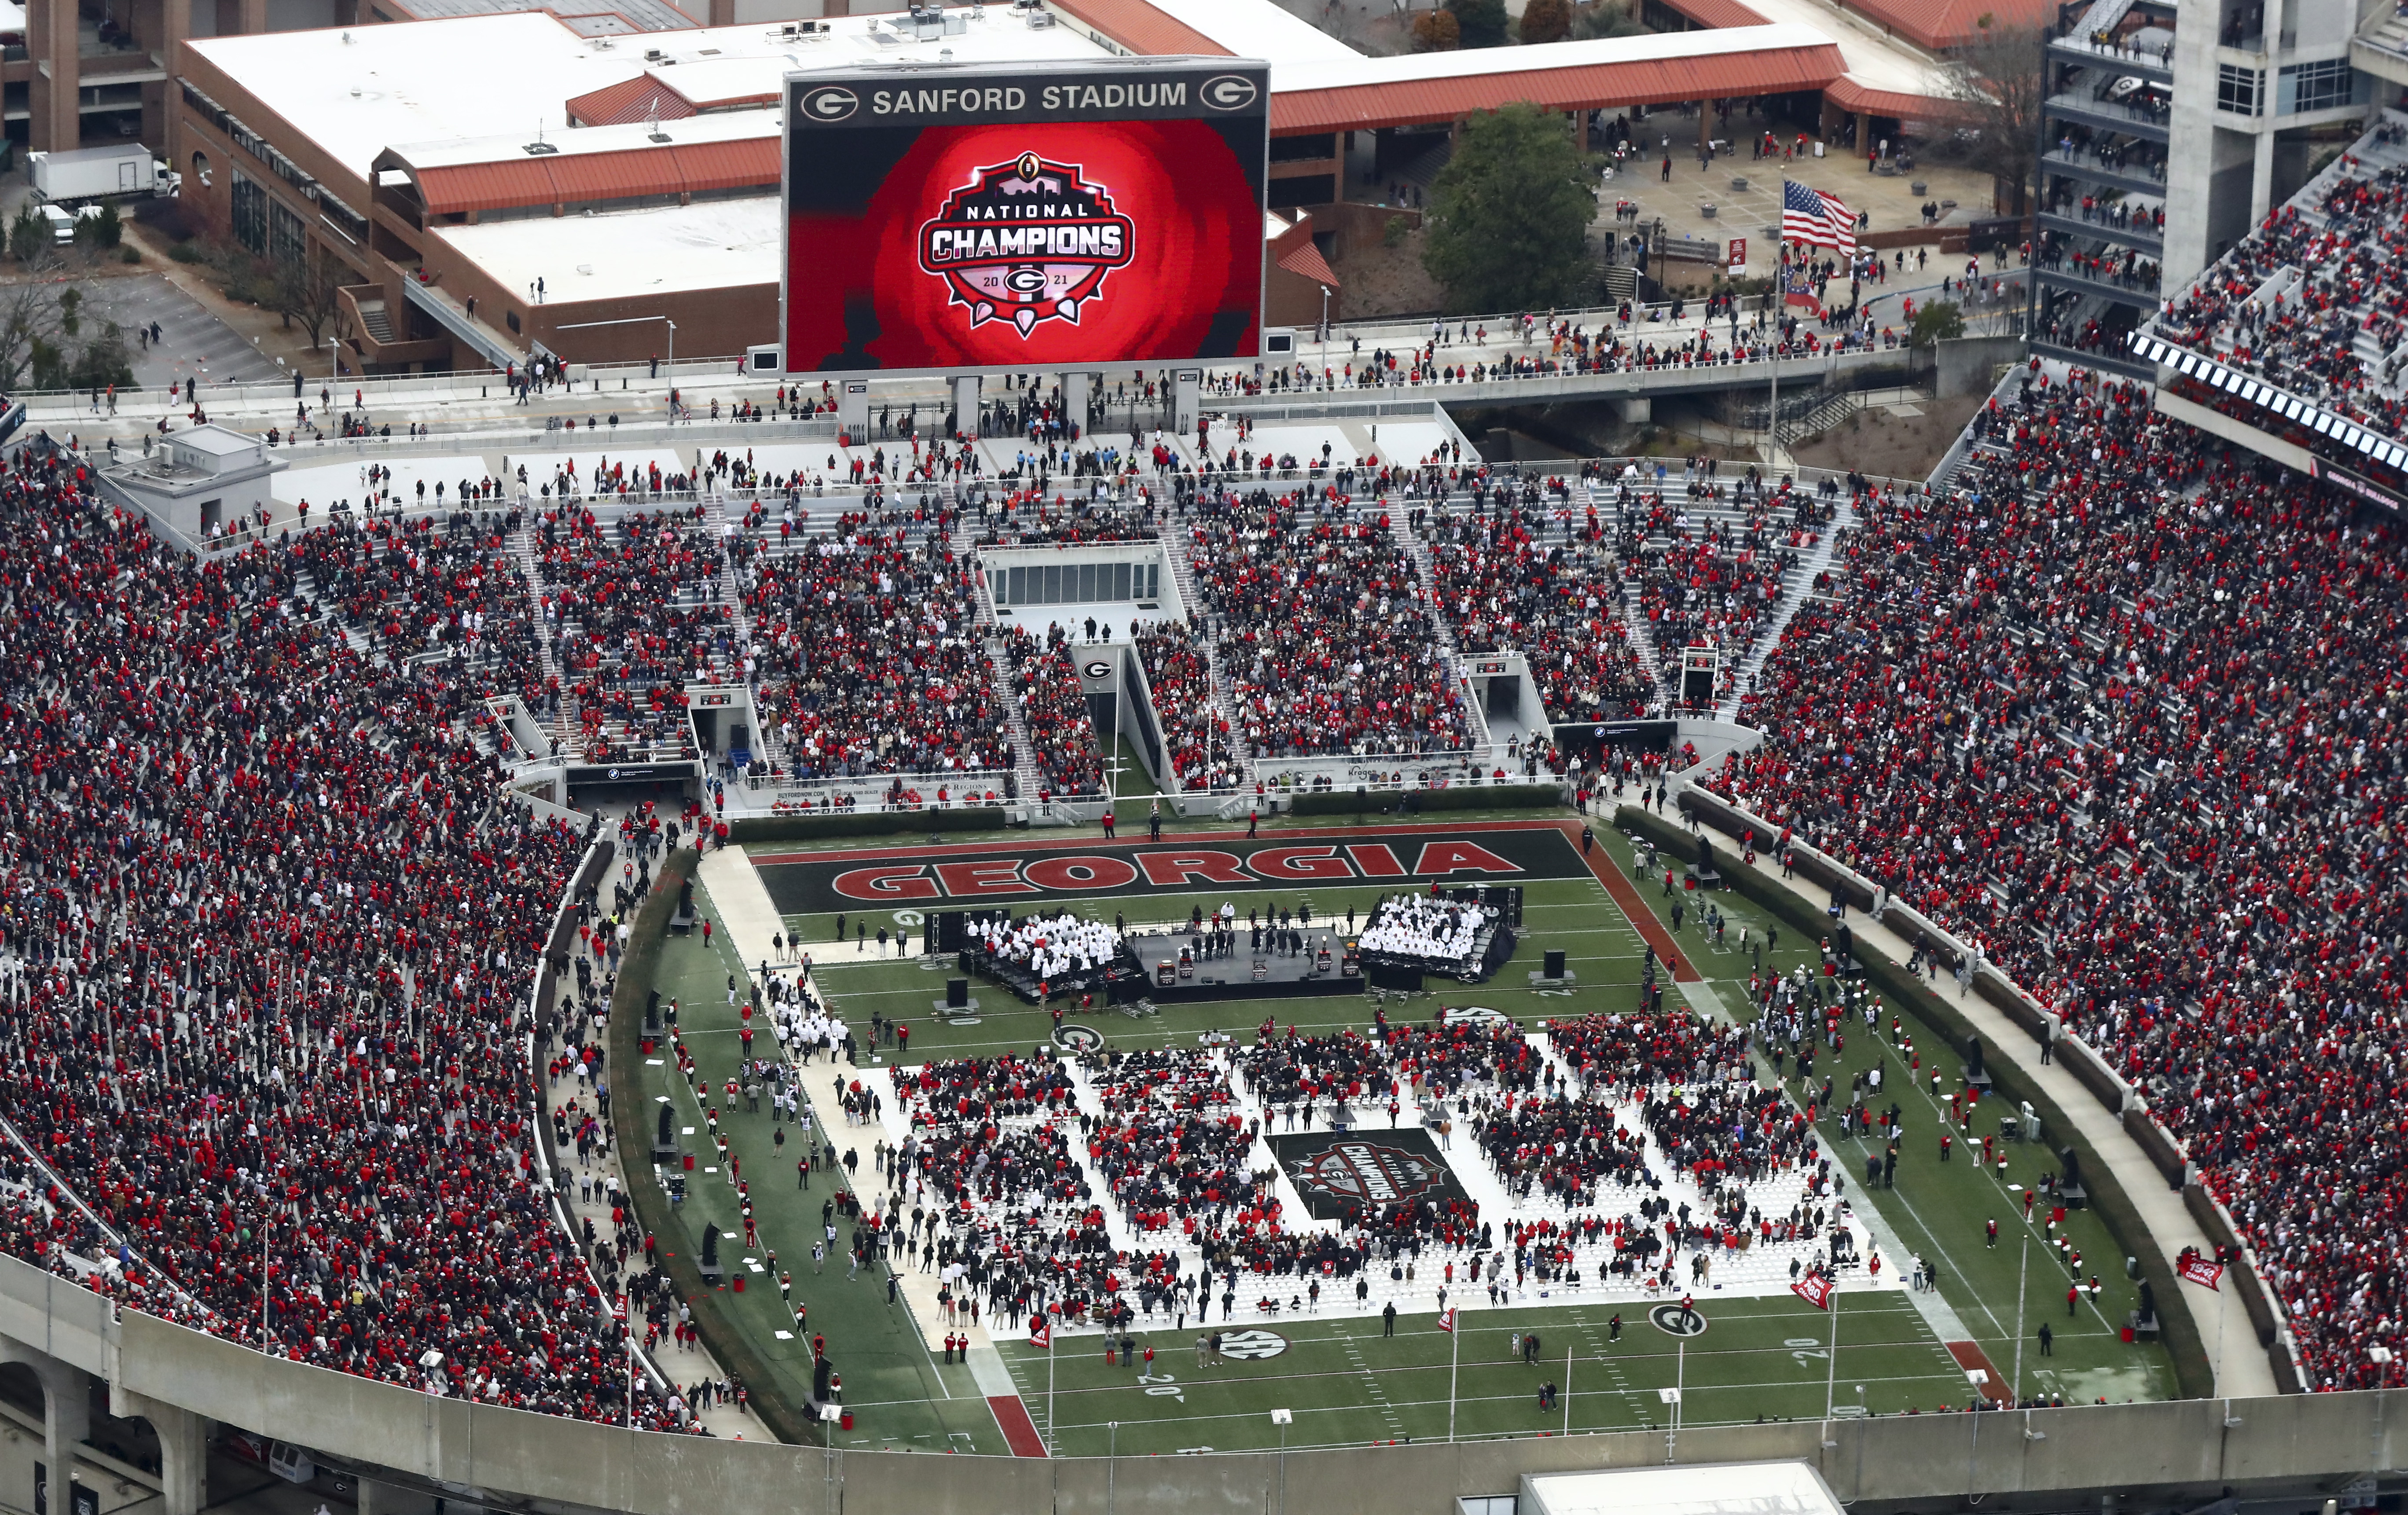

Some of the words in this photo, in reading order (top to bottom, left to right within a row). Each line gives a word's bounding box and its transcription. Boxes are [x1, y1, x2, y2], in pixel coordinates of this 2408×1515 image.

[872, 87, 1025, 115] SANFORD
[1042, 81, 1187, 109] STADIUM
[967, 204, 1088, 220] NATIONAL
[932, 224, 1122, 262] CHAMPIONS
[983, 275, 999, 288] 20
[1054, 273, 1068, 286] 21
[1348, 766, 1372, 780] Kroge
[832, 840, 1526, 901] GEORGIA
[1340, 1137, 1397, 1200] CHAMPIONS
[1379, 1153, 1411, 1189] NATIONAL
[2185, 1271, 2213, 1287] CHAMPS
[2190, 1262, 2215, 1280] 1942
[1783, 1338, 1830, 1359] 20
[1137, 1373, 1182, 1396] 20
